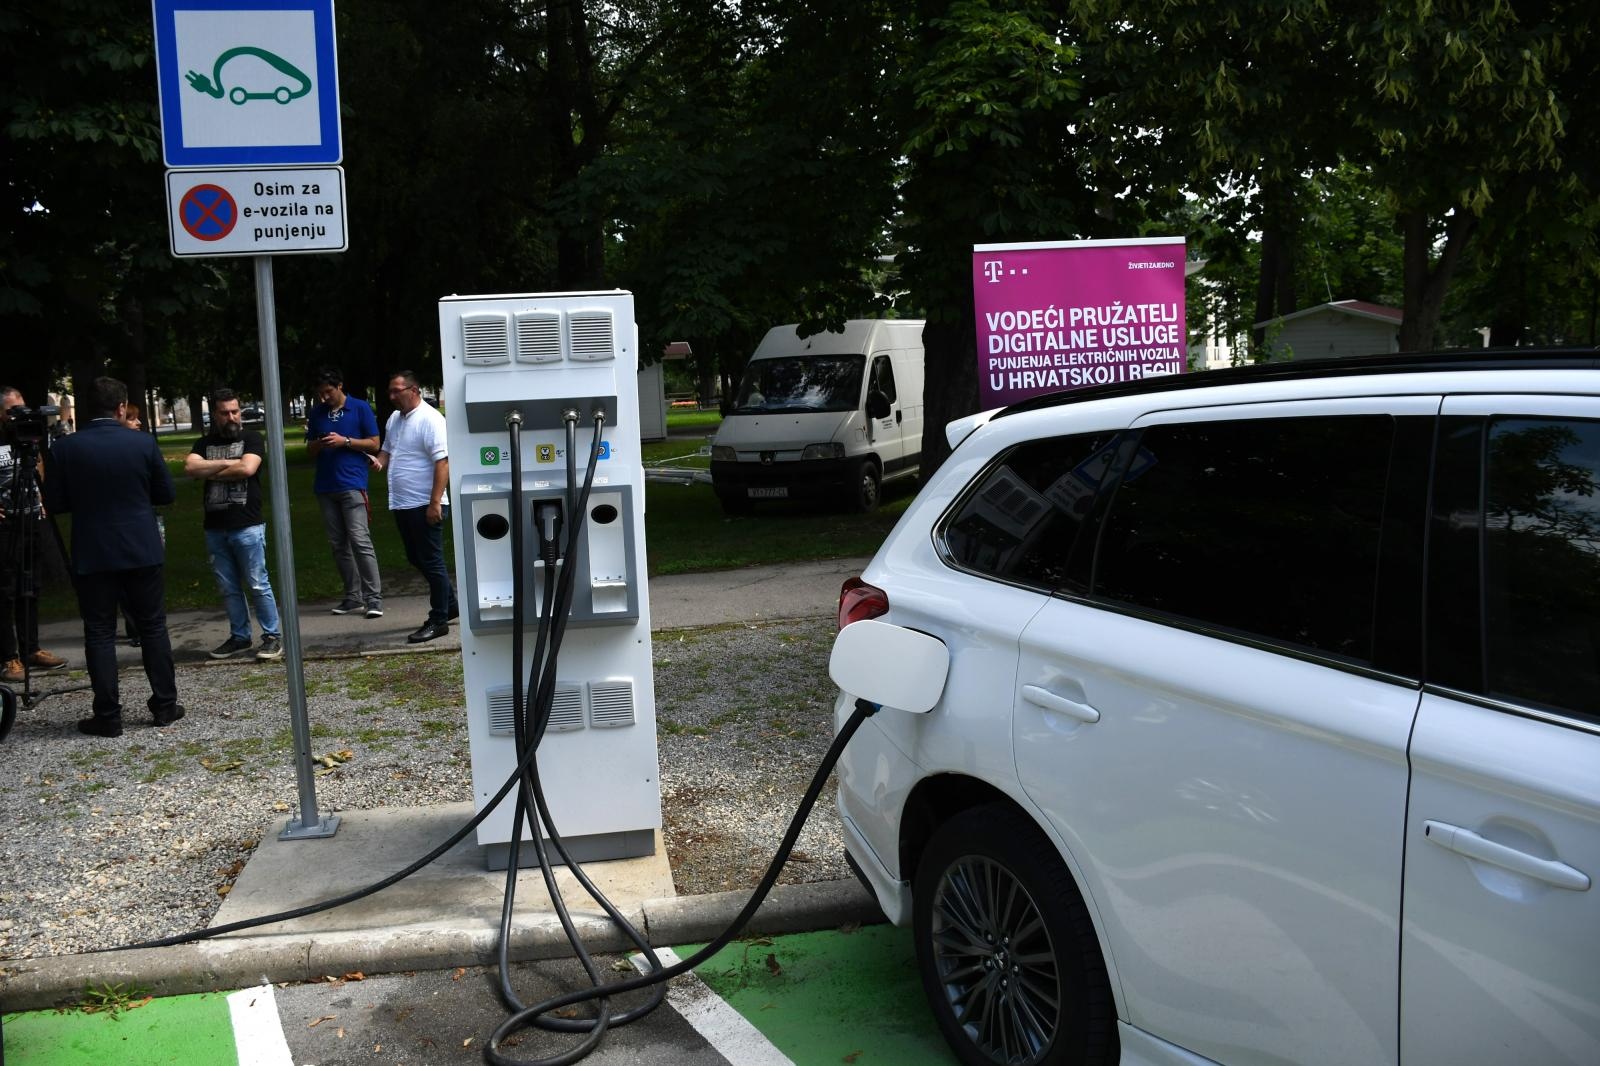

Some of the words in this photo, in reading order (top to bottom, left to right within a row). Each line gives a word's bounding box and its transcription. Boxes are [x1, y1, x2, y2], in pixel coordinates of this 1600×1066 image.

[254, 182, 295, 196] Osim
[301, 184, 320, 195] za
[243, 202, 308, 218] e-vozila
[315, 204, 334, 215] na
[254, 223, 326, 242] punjenju
[1149, 261, 1175, 269] ZAJEDNO
[986, 305, 1065, 332] VODEĆI
[1070, 301, 1178, 327] PRUŽATELJ
[988, 329, 1098, 354] DIGITALNE
[1103, 324, 1179, 347] USLUGE
[989, 354, 1051, 371] PUNJENJA
[1054, 348, 1137, 367] ELEKTRIČNIH
[1139, 346, 1180, 361] VOZILA
[990, 372, 1004, 391] U
[1008, 366, 1115, 390] HRVATSKOJ
[1120, 366, 1125, 381] I
